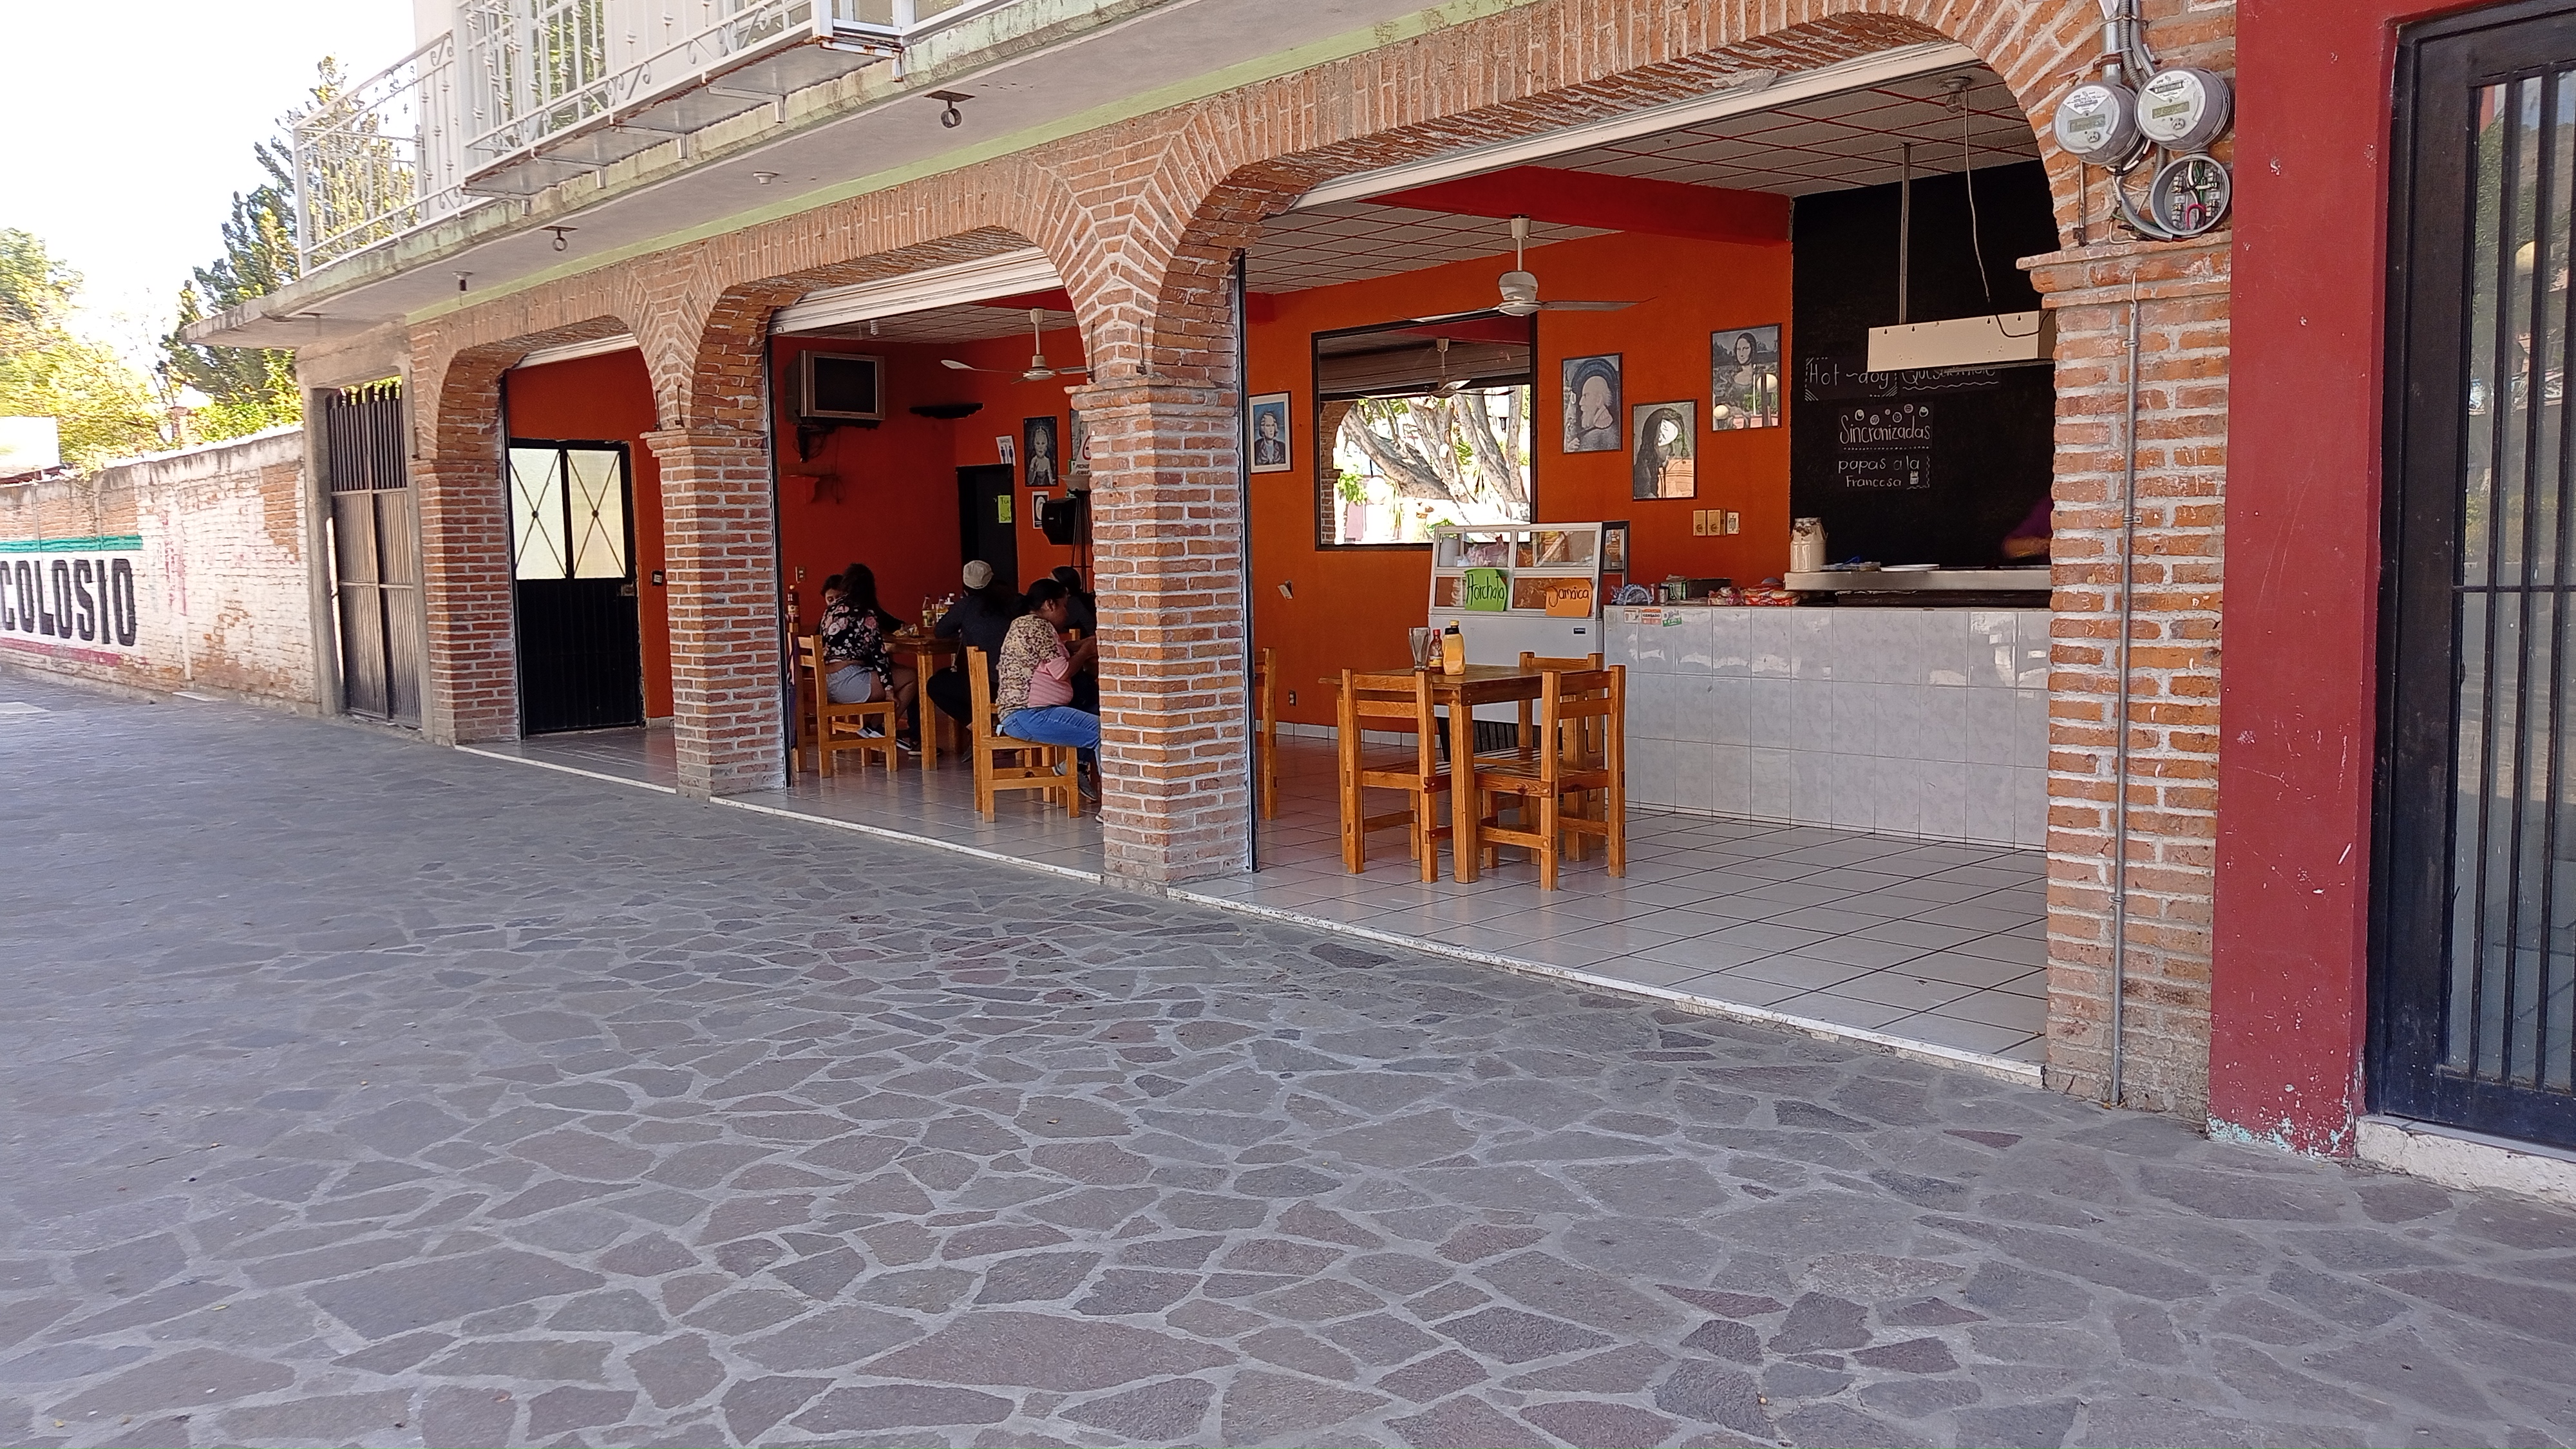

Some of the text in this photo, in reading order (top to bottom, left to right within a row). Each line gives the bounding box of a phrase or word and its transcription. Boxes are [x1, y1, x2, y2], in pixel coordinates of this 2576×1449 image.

[1840, 415, 1931, 444] Sincronizadas
[1838, 455, 1920, 475] papas a la
[0, 558, 137, 647] COLOSIO
[1466, 573, 1505, 606] Horchata
[1547, 585, 1589, 608] Jamaica
